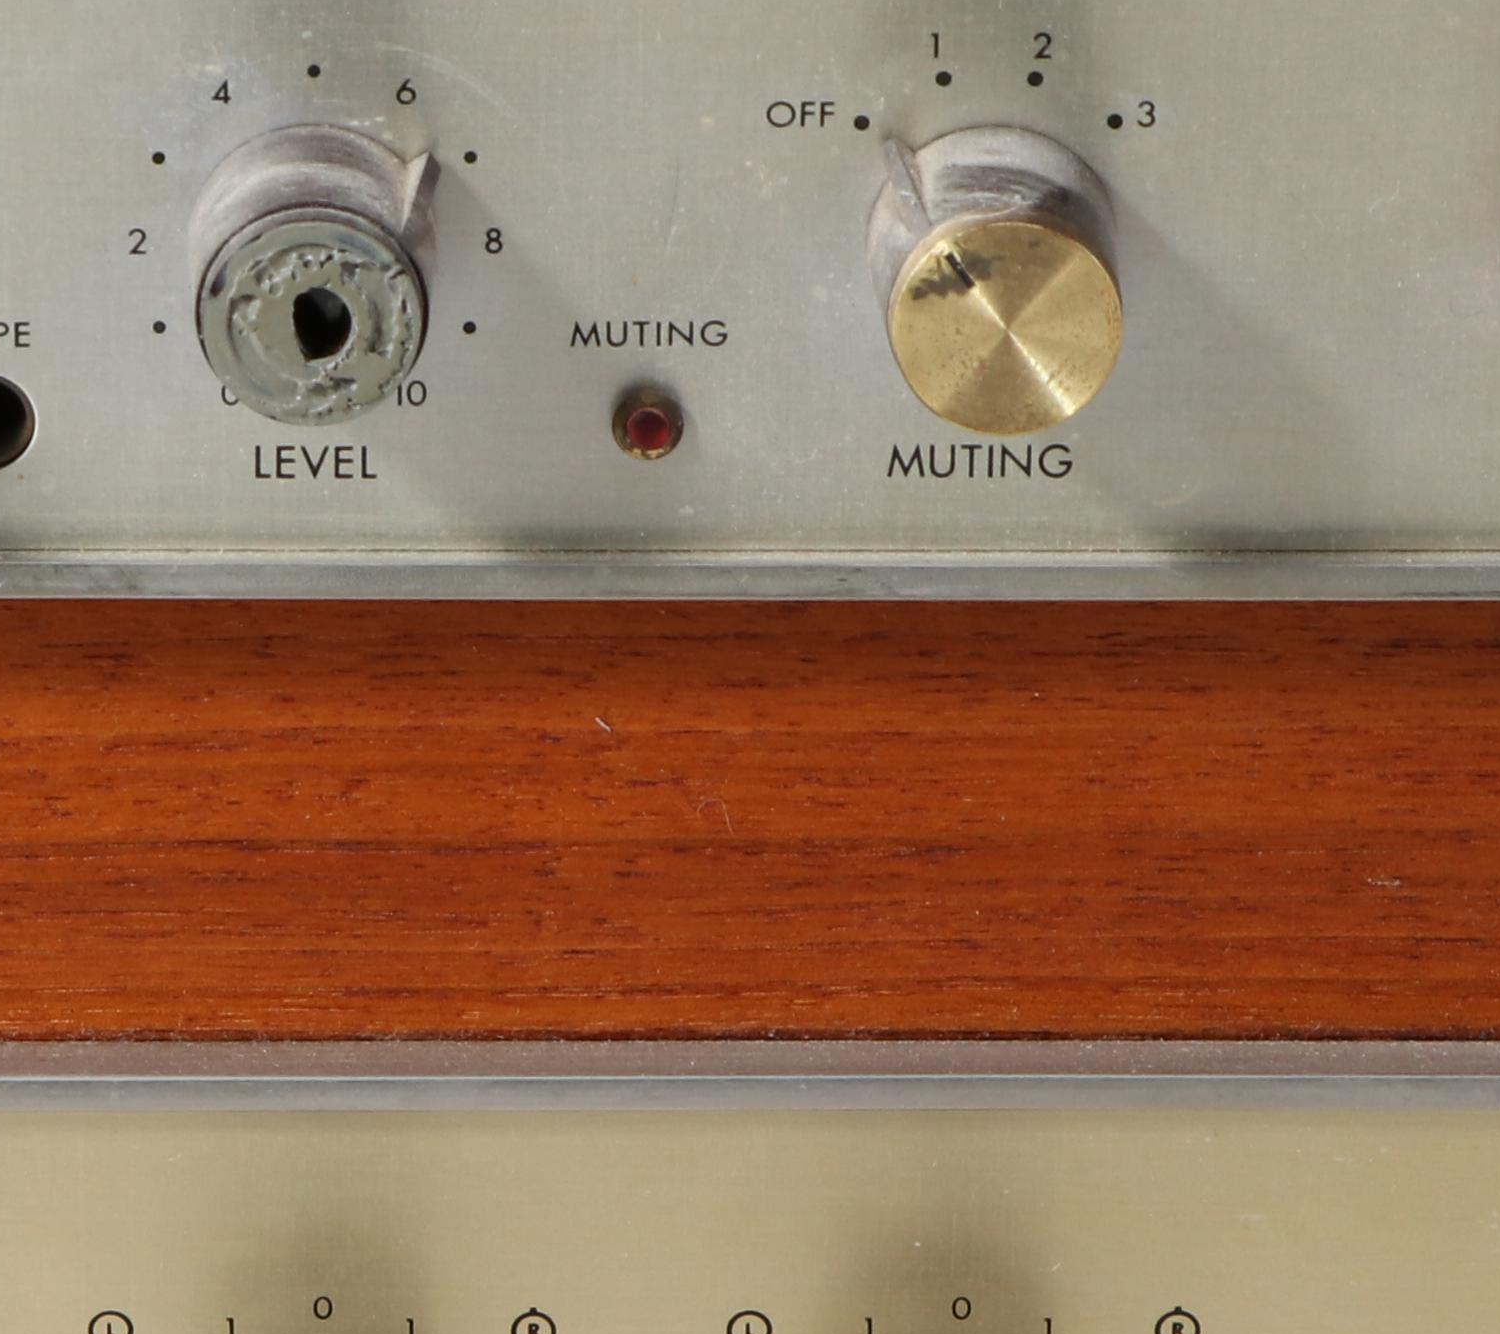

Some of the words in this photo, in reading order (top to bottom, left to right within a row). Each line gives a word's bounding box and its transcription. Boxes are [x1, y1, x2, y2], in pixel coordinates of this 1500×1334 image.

[931, 32, 939, 59] 1
[1033, 32, 1052, 60] 2
[212, 80, 231, 105] 4
[395, 78, 417, 105] 6
[766, 101, 835, 128] OFF
[1137, 100, 1156, 128] 3
[128, 228, 147, 255] 2
[484, 227, 503, 255] 8
[570, 320, 728, 348] MUTING
[396, 380, 427, 407] 10
[255, 445, 377, 479] LEVEL
[887, 443, 1073, 479] MUTING
[313, 1296, 333, 1320] 0
[951, 1296, 972, 1321] 0
